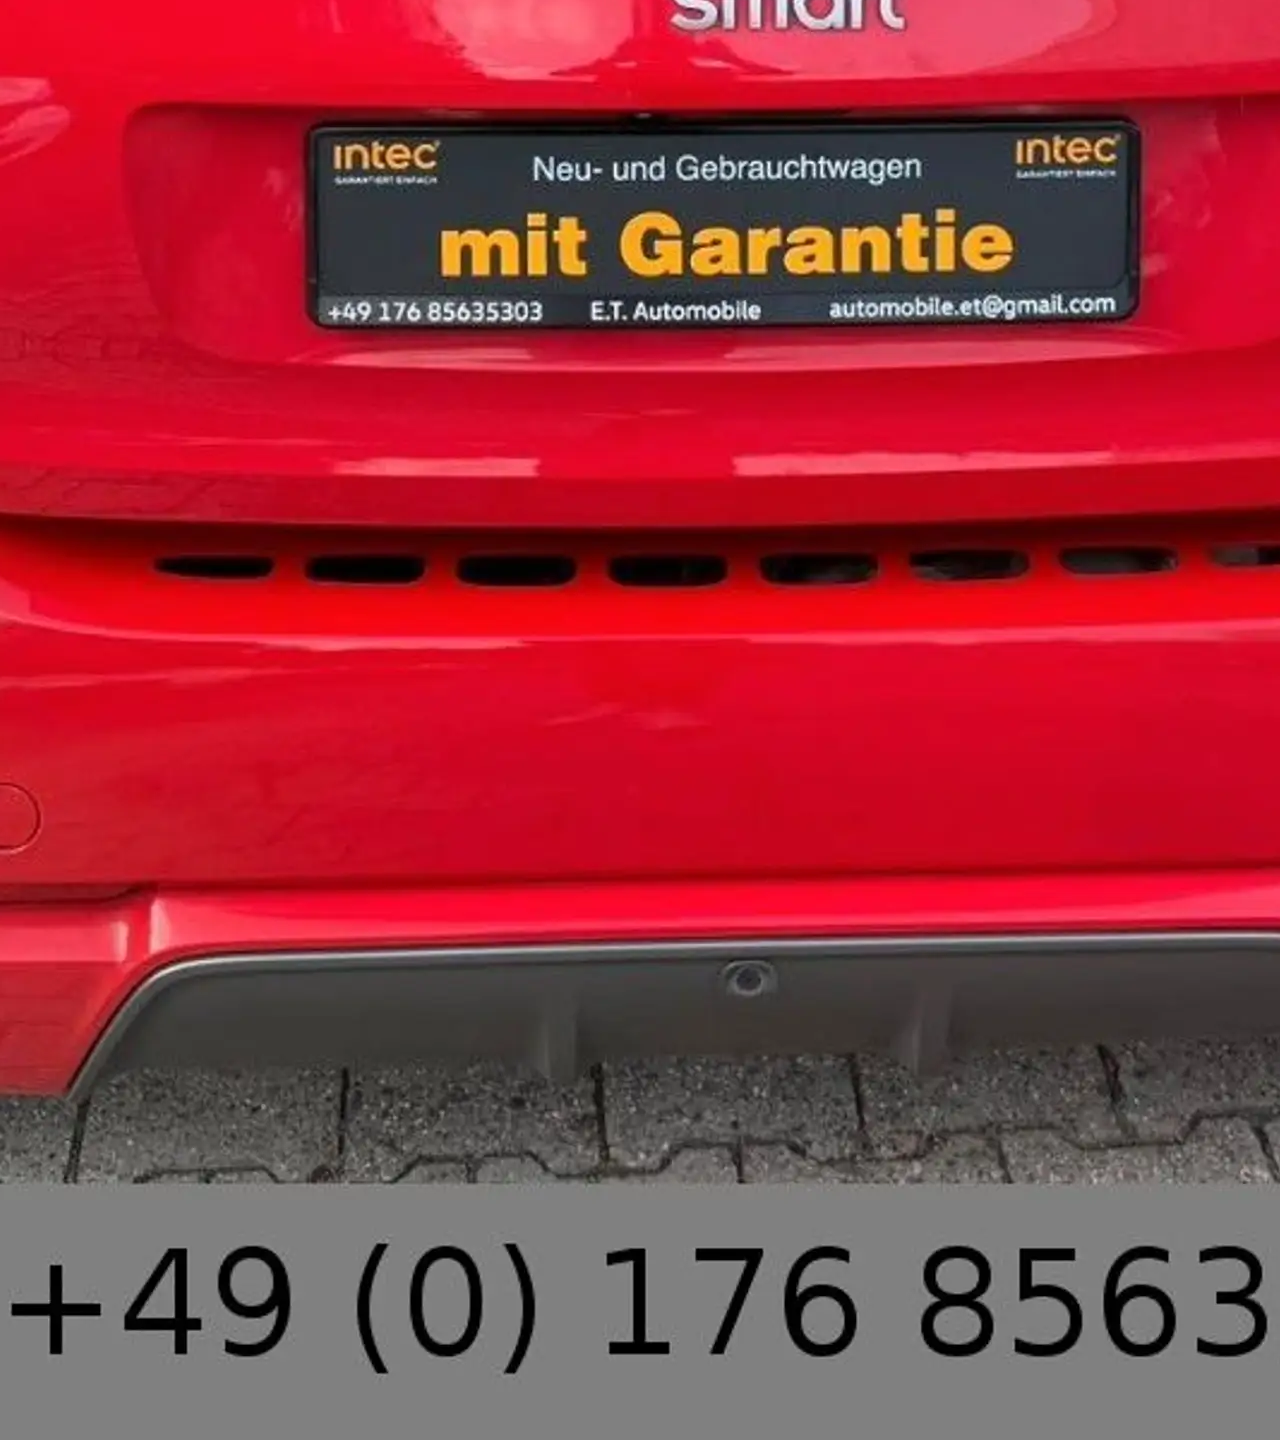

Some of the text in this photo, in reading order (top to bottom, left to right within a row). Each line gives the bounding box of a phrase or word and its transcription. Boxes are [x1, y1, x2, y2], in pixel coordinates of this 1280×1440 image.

[333, 139, 438, 170] intec
[1015, 134, 1118, 164] intec
[533, 153, 921, 186] Neu- und Gebrauchtwagen
[439, 208, 1014, 278] mit Garantie
[327, 301, 543, 322] +49 176 85635303
[590, 300, 762, 321] E.T. Automobile
[829, 294, 1117, 320] automobile.et@gmail.com
